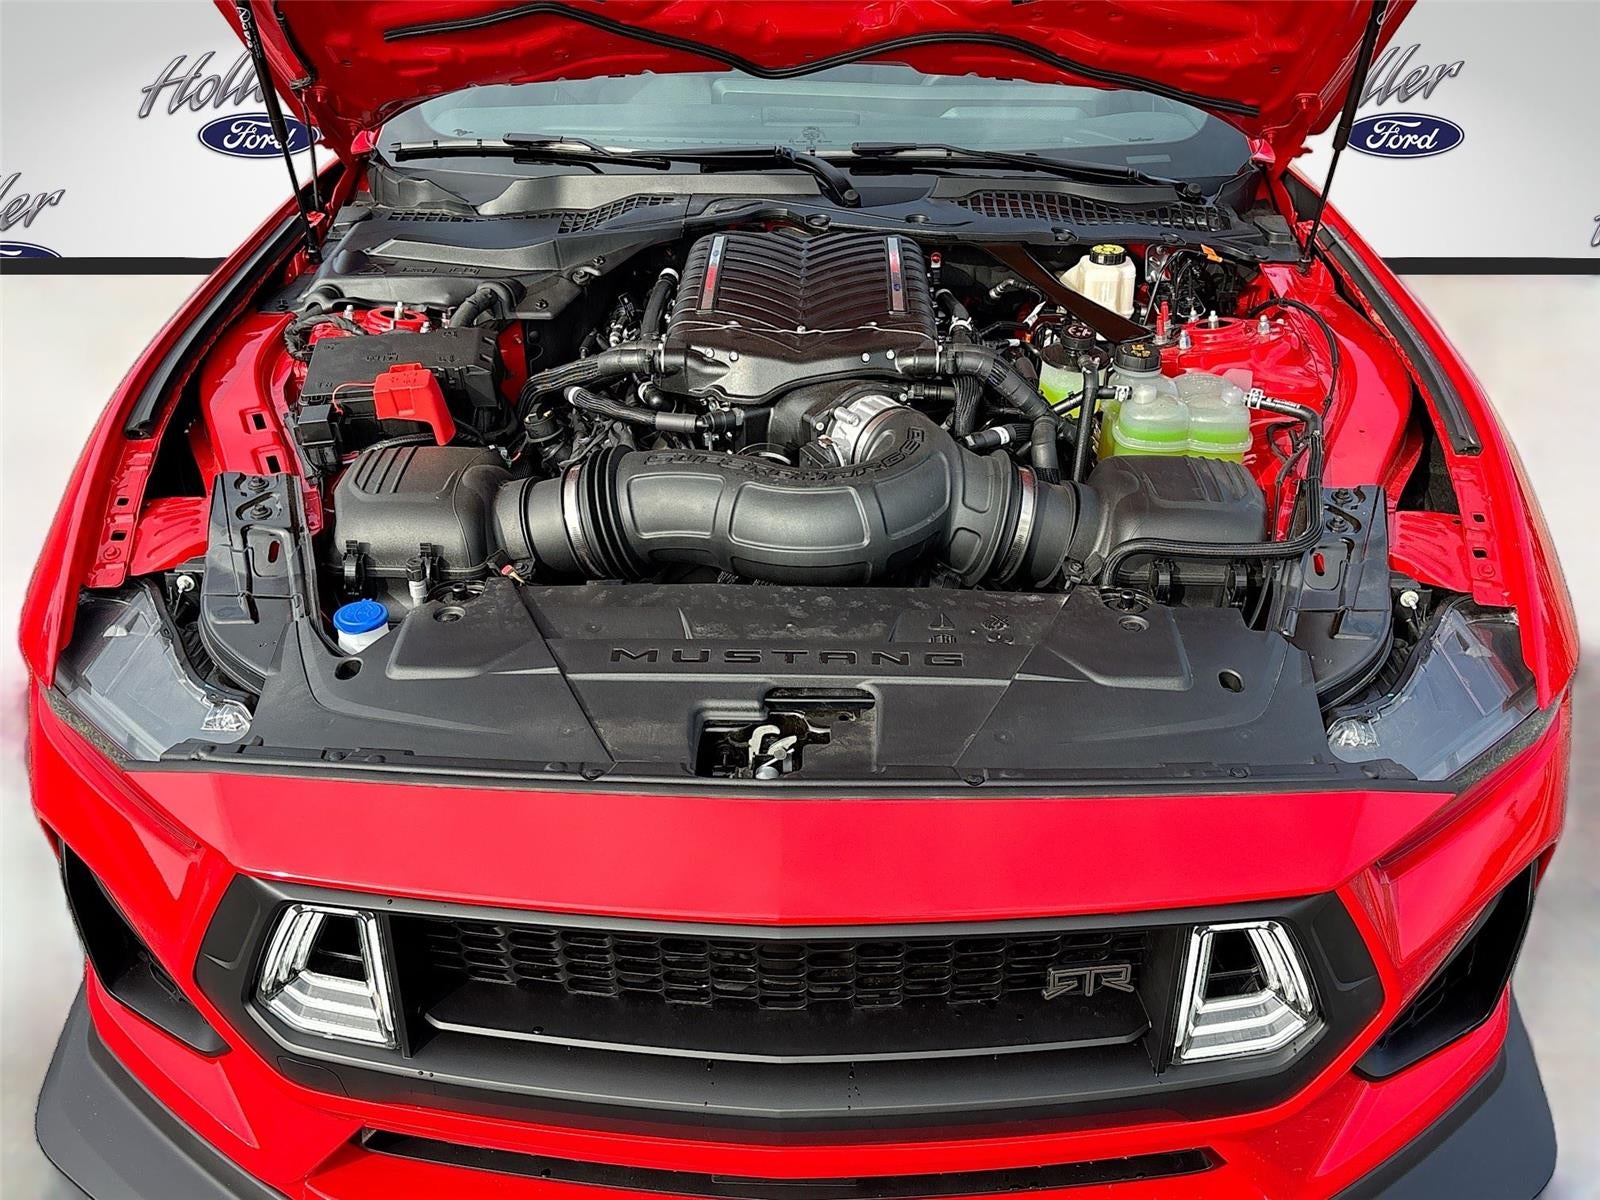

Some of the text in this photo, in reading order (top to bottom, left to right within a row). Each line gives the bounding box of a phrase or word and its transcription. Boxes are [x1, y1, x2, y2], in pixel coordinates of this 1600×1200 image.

[223, 119, 297, 150] Ford
[1366, 119, 1440, 150] Ford
[610, 647, 965, 667] MUSTANG
